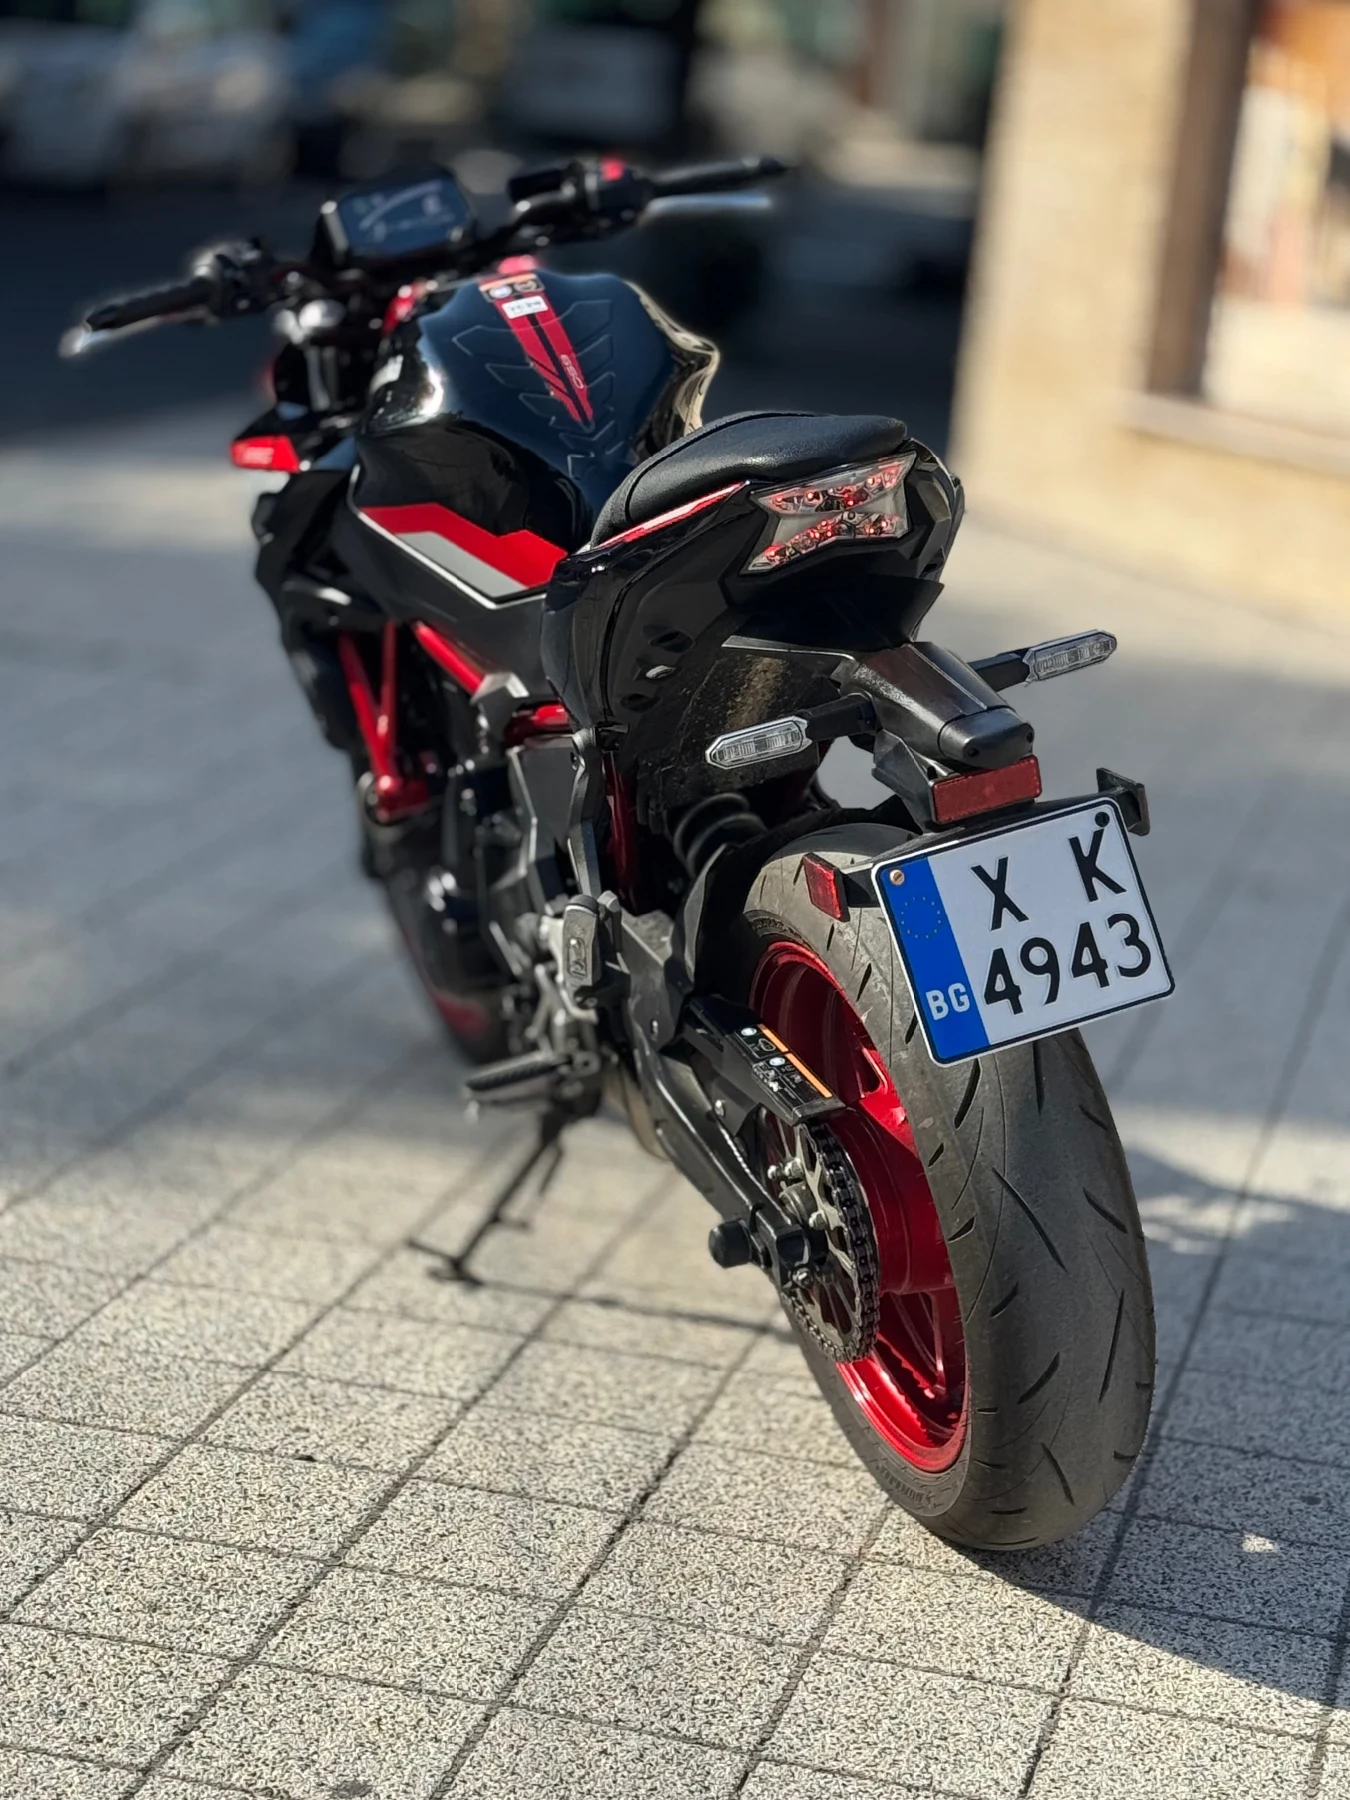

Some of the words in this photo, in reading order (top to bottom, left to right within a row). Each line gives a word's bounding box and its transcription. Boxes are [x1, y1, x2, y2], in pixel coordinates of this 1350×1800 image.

[970, 856, 1029, 931] X
[1068, 826, 1127, 902] K
[925, 982, 971, 1021] BG
[983, 913, 1152, 1015] 4943
